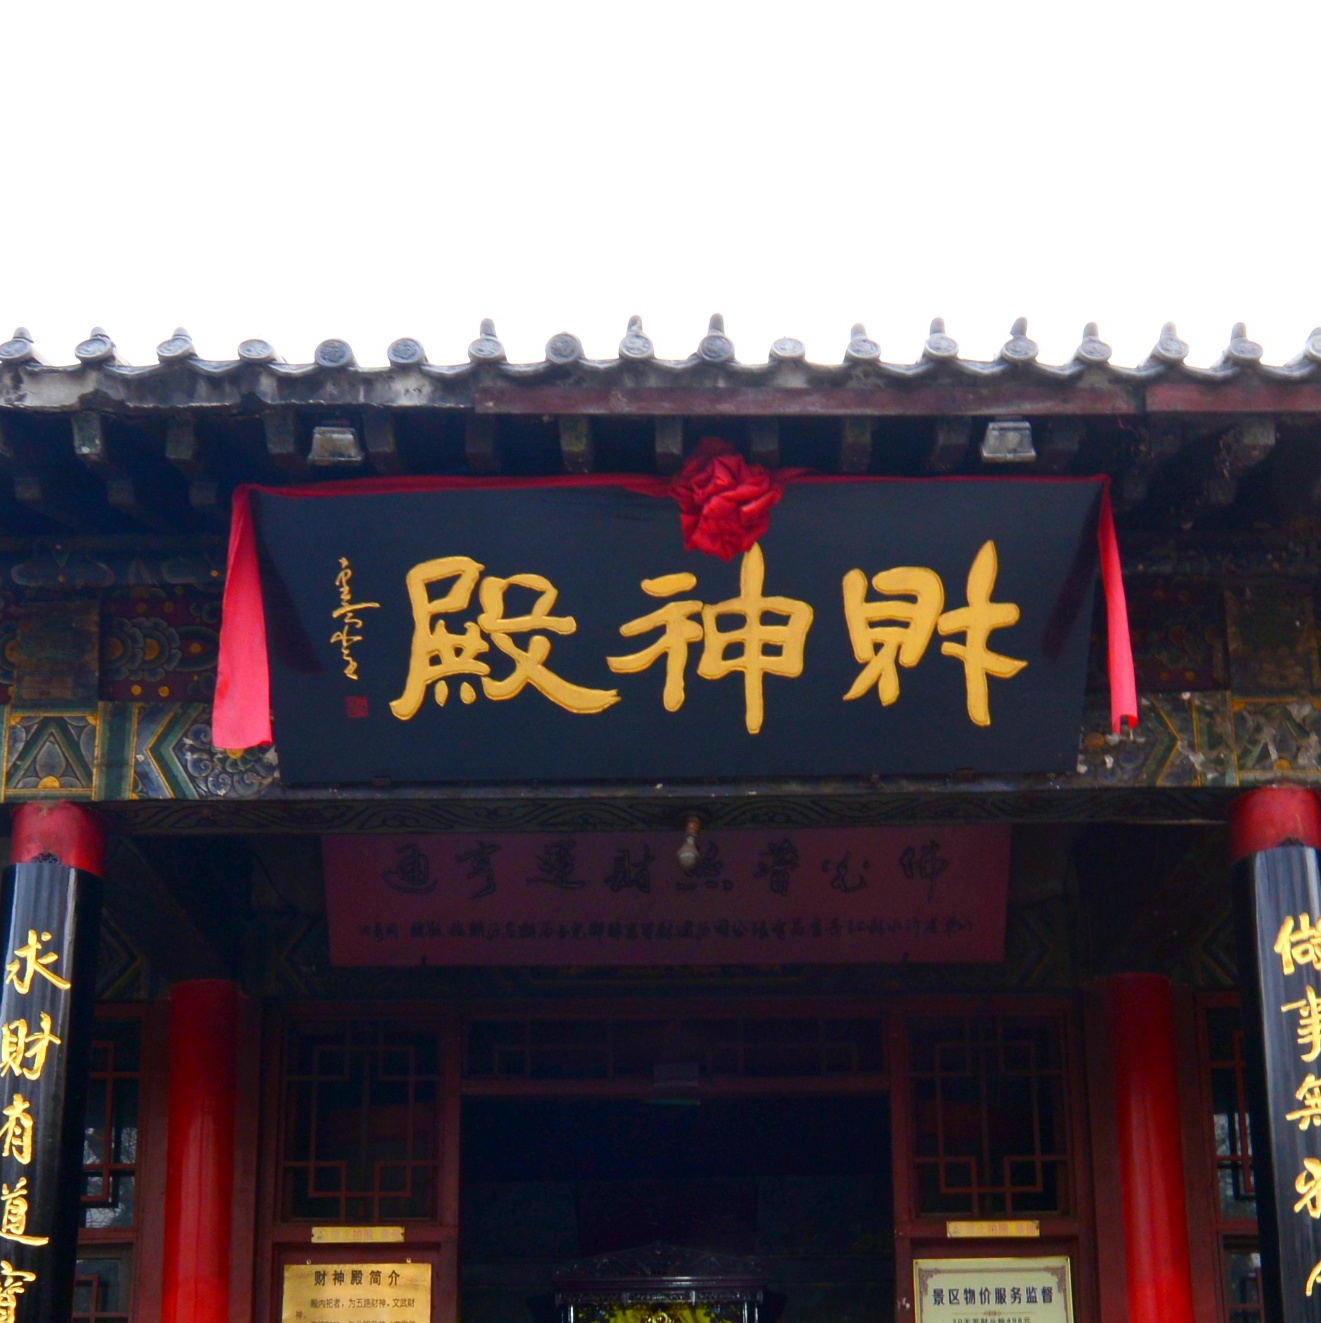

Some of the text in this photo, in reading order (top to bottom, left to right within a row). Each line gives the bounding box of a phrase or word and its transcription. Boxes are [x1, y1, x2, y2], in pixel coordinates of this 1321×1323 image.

[314, 1270, 400, 1286] 财神殿简介
[933, 1286, 1054, 1304] 景区物价服务监督
